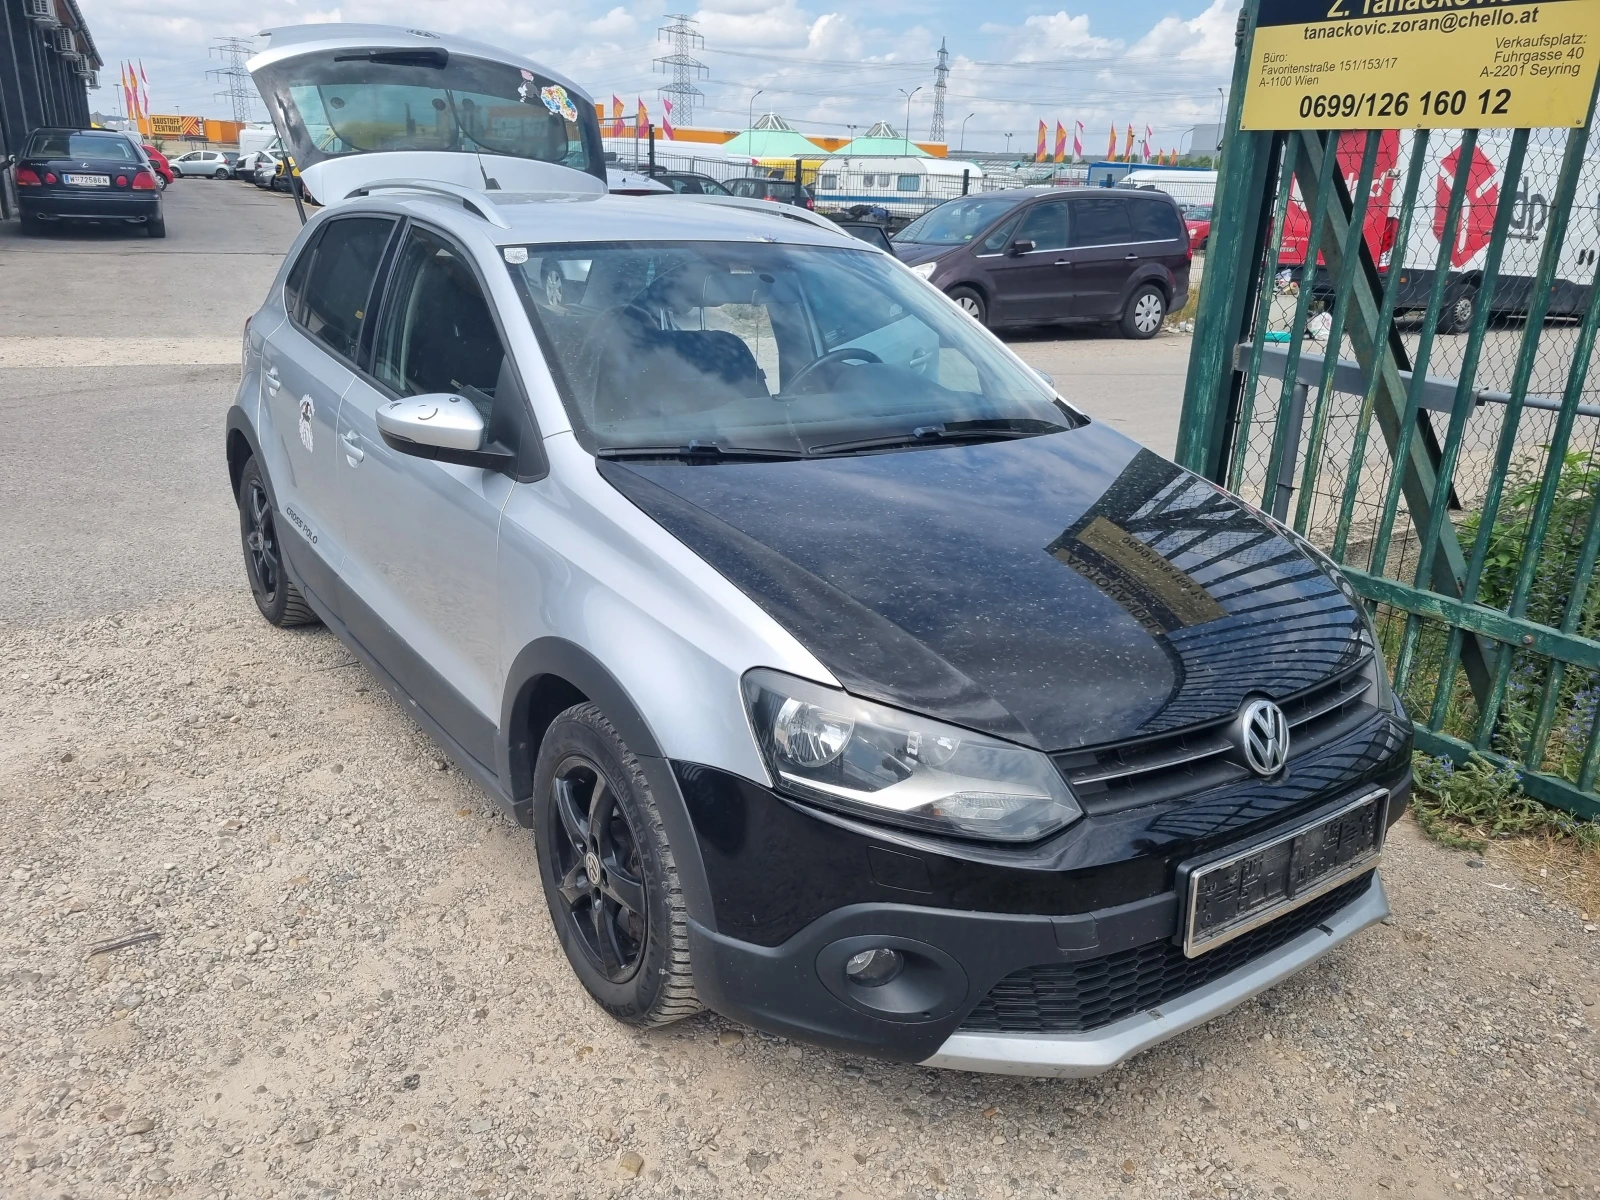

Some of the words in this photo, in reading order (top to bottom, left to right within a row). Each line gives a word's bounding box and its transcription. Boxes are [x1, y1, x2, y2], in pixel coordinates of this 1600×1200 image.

[1303, 7, 1539, 41] tanackovic.zoran@chello.at
[1495, 33, 1588, 50] Verkaufsplatz:
[1263, 52, 1288, 64] Büro:
[1494, 49, 1563, 65] Fuhrgasse
[1566, 46, 1585, 60] 40
[1261, 61, 1336, 75] Favoritenstraße
[1339, 57, 1398, 71] 151/153/17
[1479, 64, 1526, 78] A-2201
[1529, 62, 1581, 78] Seyring
[1258, 75, 1292, 88] A-1100
[1295, 75, 1319, 87] Wien
[1299, 91, 1410, 119] 0699/126
[1418, 89, 1467, 116] 160
[1477, 88, 1512, 115] 12
[152, 117, 180, 125] BAUSTOFF
[154, 124, 182, 132] ZENTRUM
[286, 507, 304, 528] CROSS
[302, 524, 318, 544] POLO
